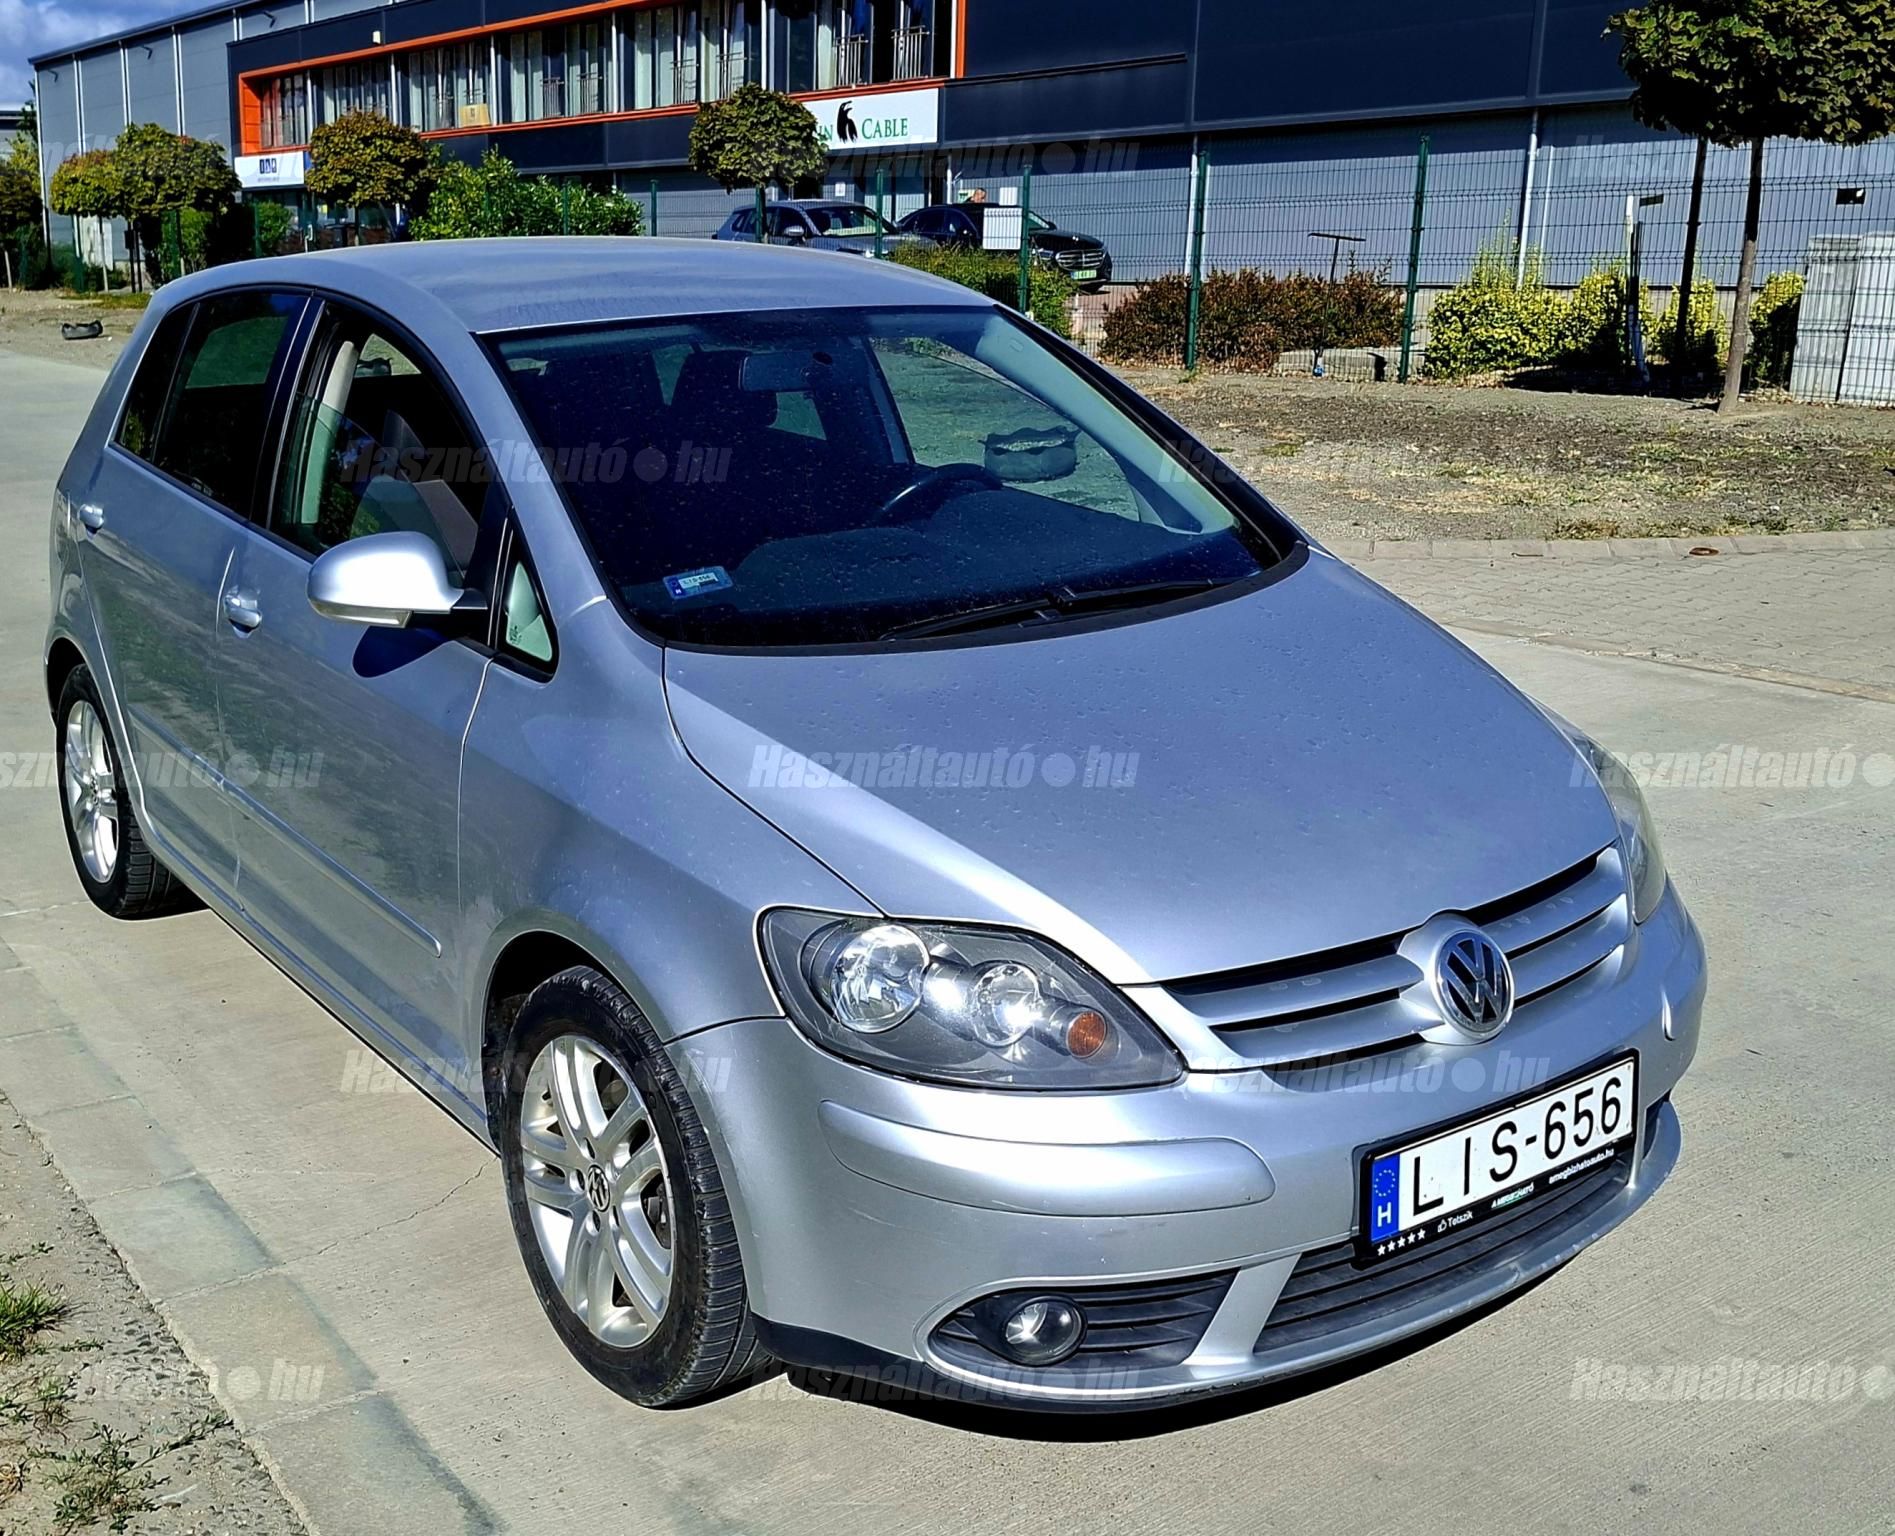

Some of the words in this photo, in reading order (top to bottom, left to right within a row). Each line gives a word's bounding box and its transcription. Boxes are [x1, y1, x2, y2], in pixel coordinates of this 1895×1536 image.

[861, 118, 908, 140] CABLE
[1412, 1076, 1623, 1217] LIS-656
[1377, 1201, 1392, 1228] H
